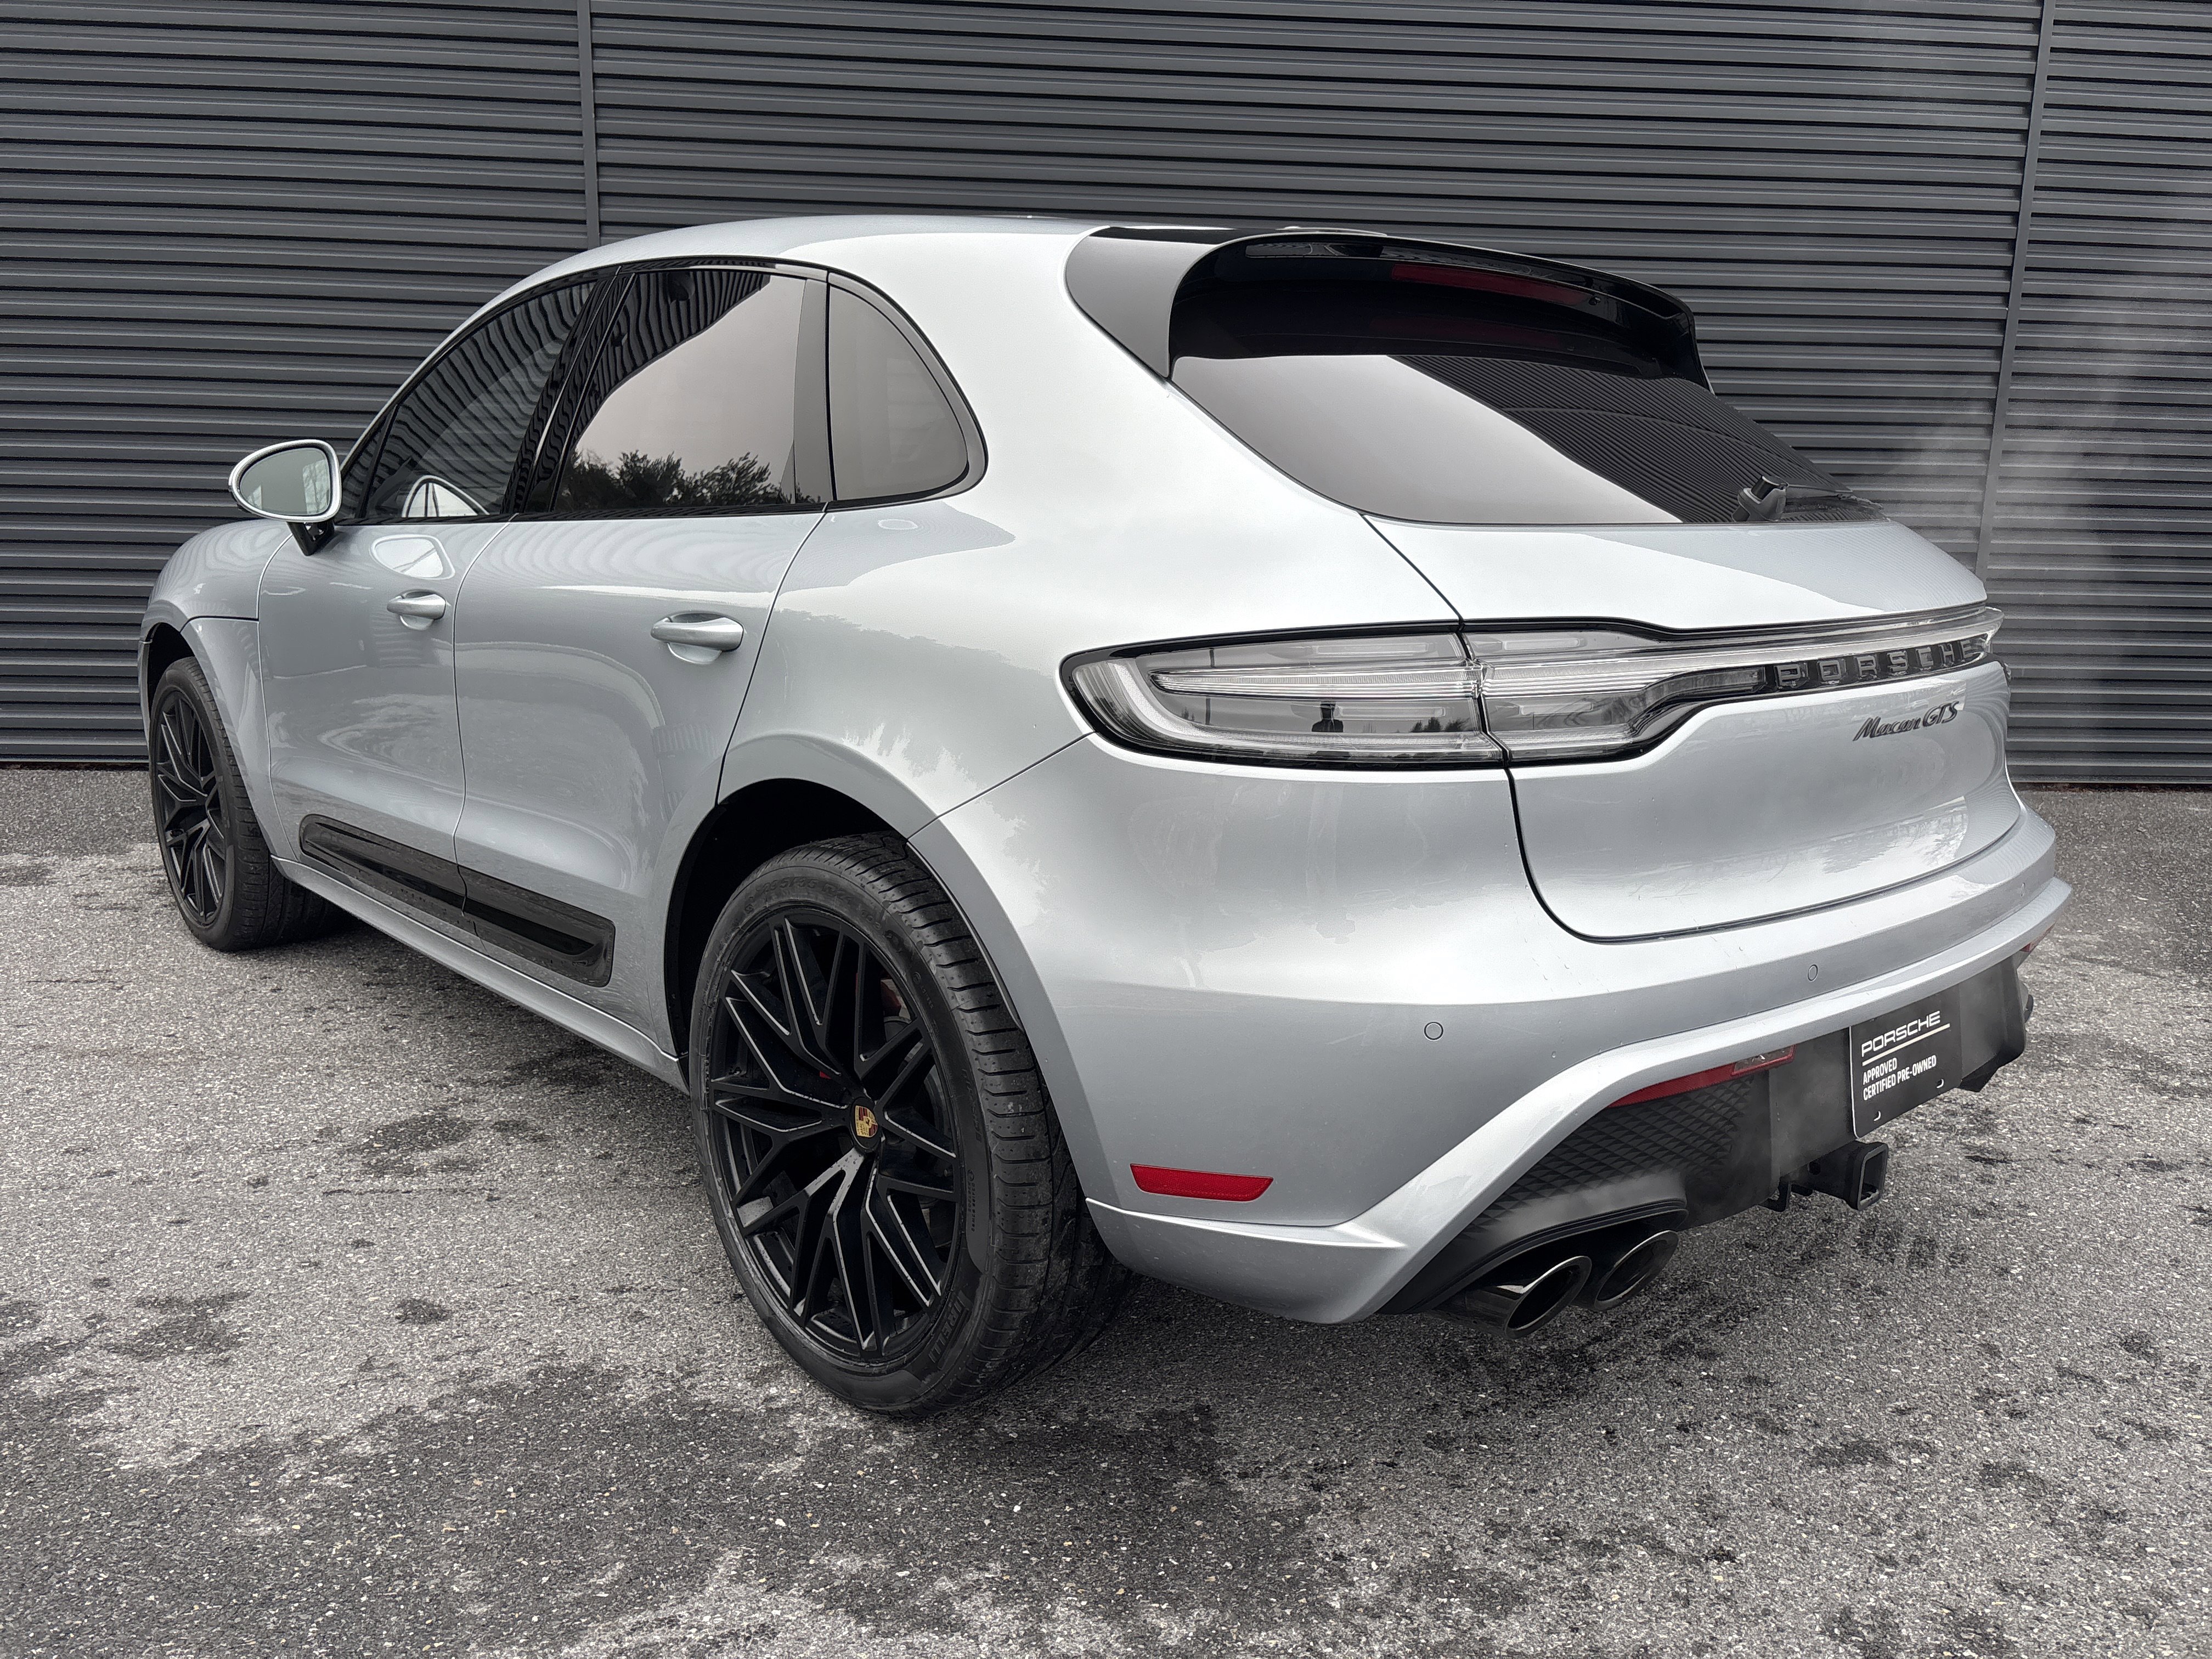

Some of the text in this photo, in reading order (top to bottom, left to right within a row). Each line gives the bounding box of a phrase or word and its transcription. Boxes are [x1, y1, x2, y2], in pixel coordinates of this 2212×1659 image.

[1774, 639, 1977, 687] PORSCHE
[1853, 701, 1959, 741] Macan GTS
[1861, 1010, 1940, 1057] PORSCHE
[1863, 1057, 1897, 1086] APPROVED
[1863, 1054, 1937, 1101] CERTIFIED PRE-OWNED
